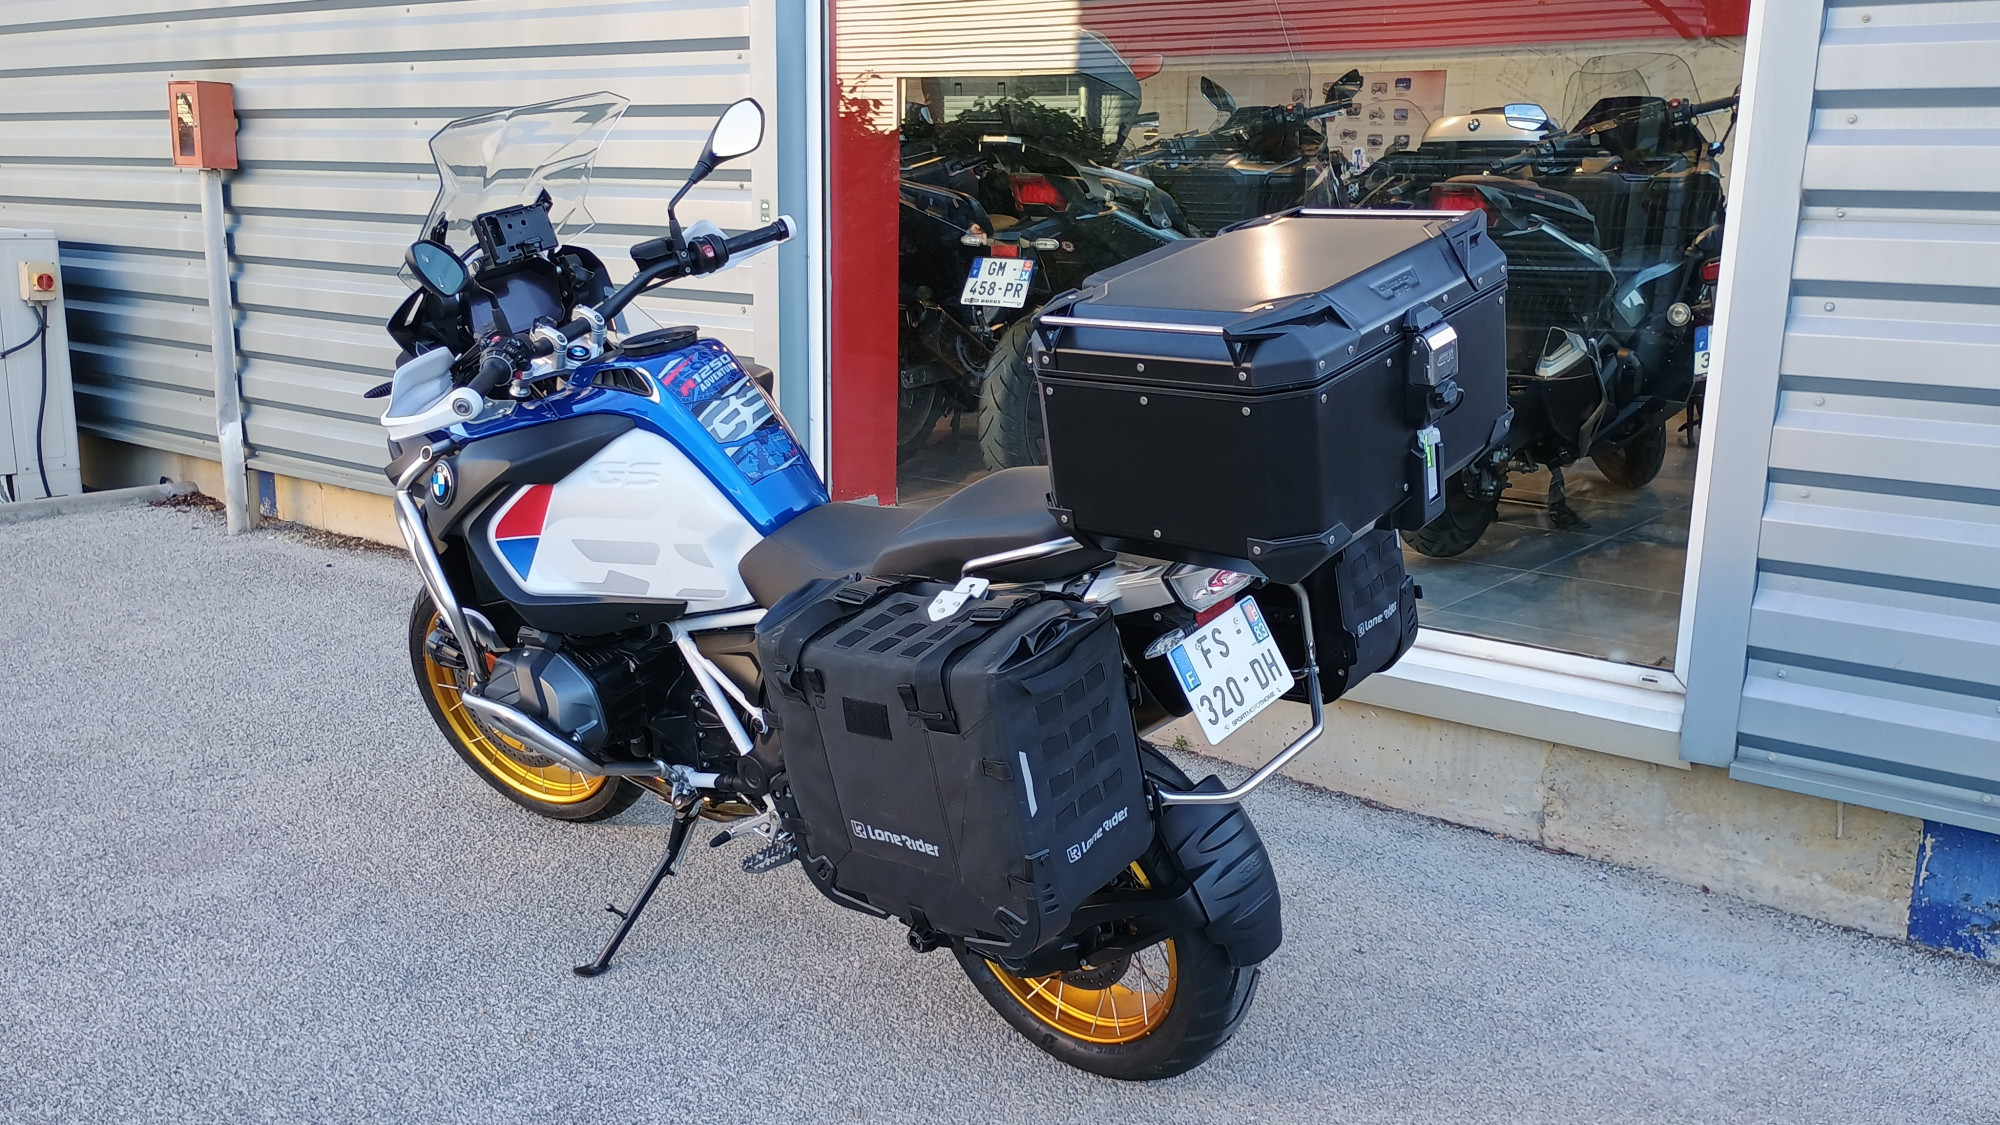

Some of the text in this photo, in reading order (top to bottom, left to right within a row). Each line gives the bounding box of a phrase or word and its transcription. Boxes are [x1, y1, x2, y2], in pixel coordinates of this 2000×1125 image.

[987, 261, 1007, 277] GM
[1020, 271, 1029, 281] 34
[969, 280, 1023, 298] 458-PR
[587, 460, 663, 488] GS
[1252, 623, 1269, 640] 83
[1197, 627, 1230, 669] FS
[1185, 670, 1201, 689] F
[1200, 648, 1283, 726] 320-DH
